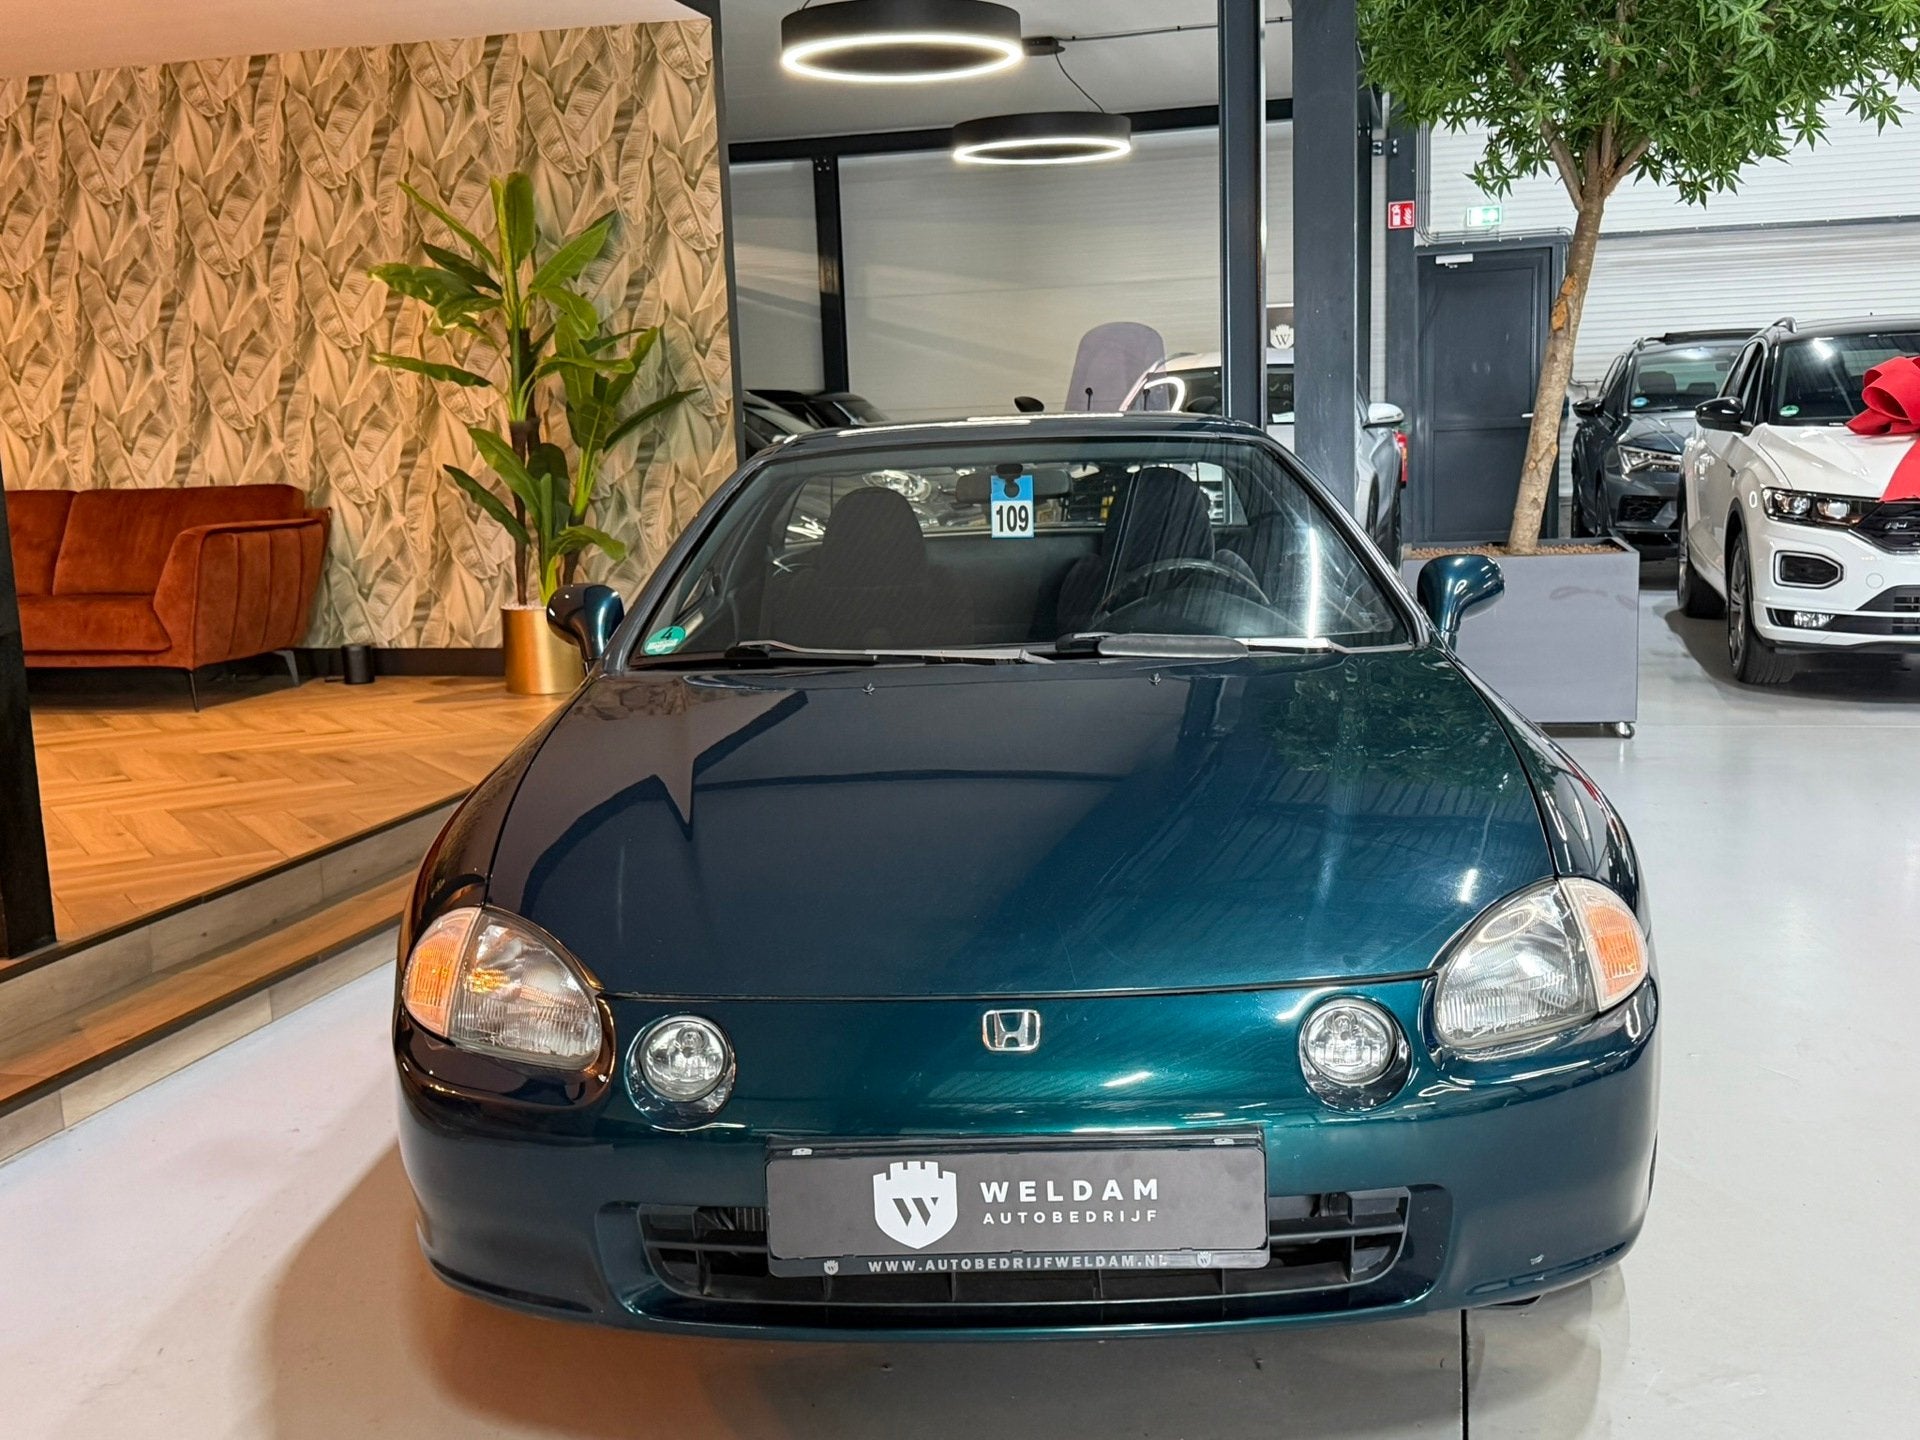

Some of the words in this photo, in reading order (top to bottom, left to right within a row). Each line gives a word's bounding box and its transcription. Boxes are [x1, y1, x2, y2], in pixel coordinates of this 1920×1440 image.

[996, 505, 1029, 532] 109
[661, 626, 673, 640] 4
[980, 1178, 1158, 1203] WELDAM
[982, 1210, 1157, 1225] AUTOBEDRIJF
[867, 1254, 1169, 1273] WWW.AUTOBEDRIJFWELDAM.NL
